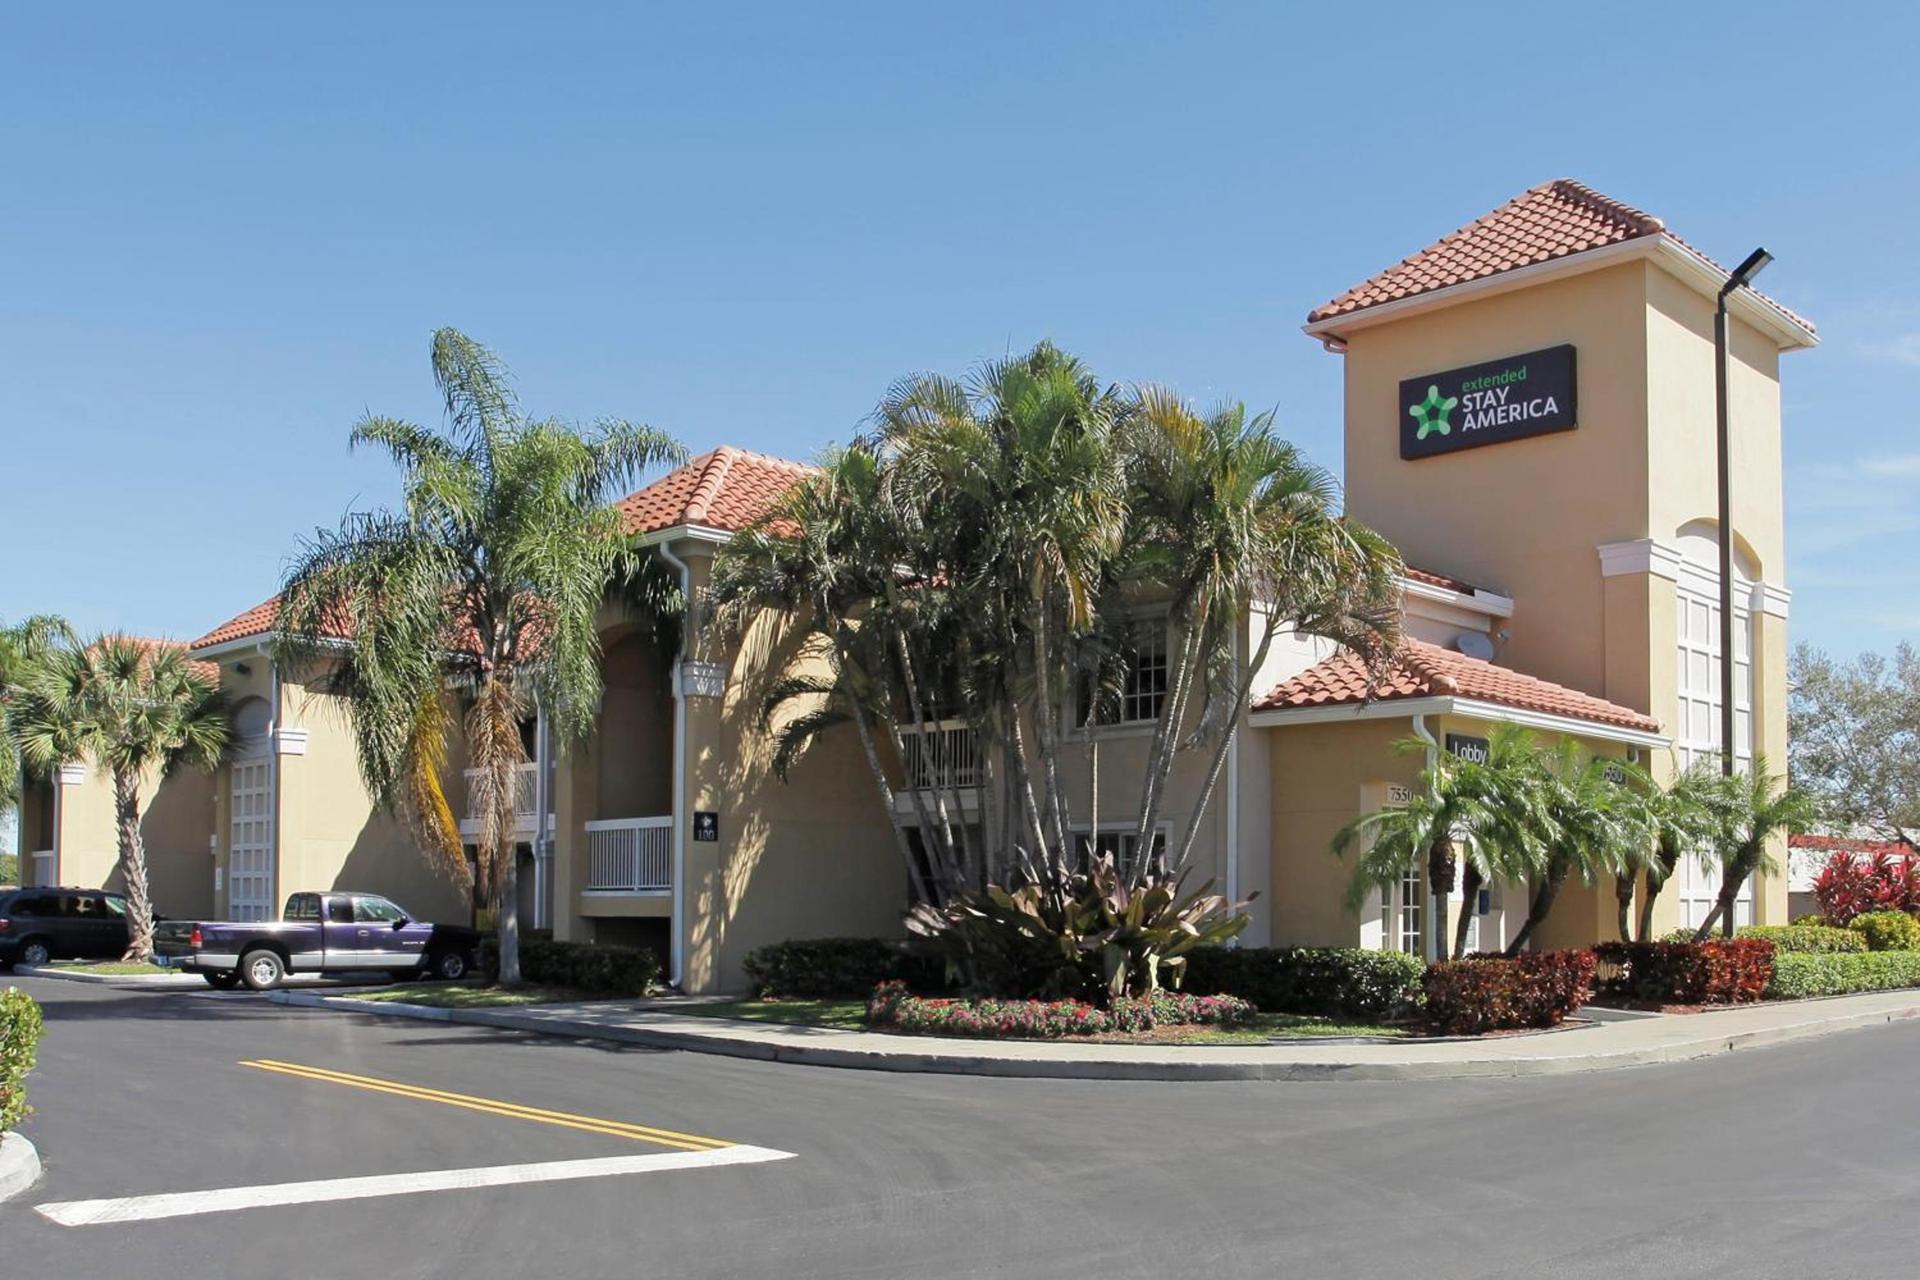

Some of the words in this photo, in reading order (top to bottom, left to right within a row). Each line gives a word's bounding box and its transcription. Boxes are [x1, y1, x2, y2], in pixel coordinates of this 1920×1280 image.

[1462, 365, 1527, 393] extended
[1462, 386, 1510, 413] STAY
[1462, 396, 1559, 432] AMERICA
[1454, 741, 1487, 767] Lobby
